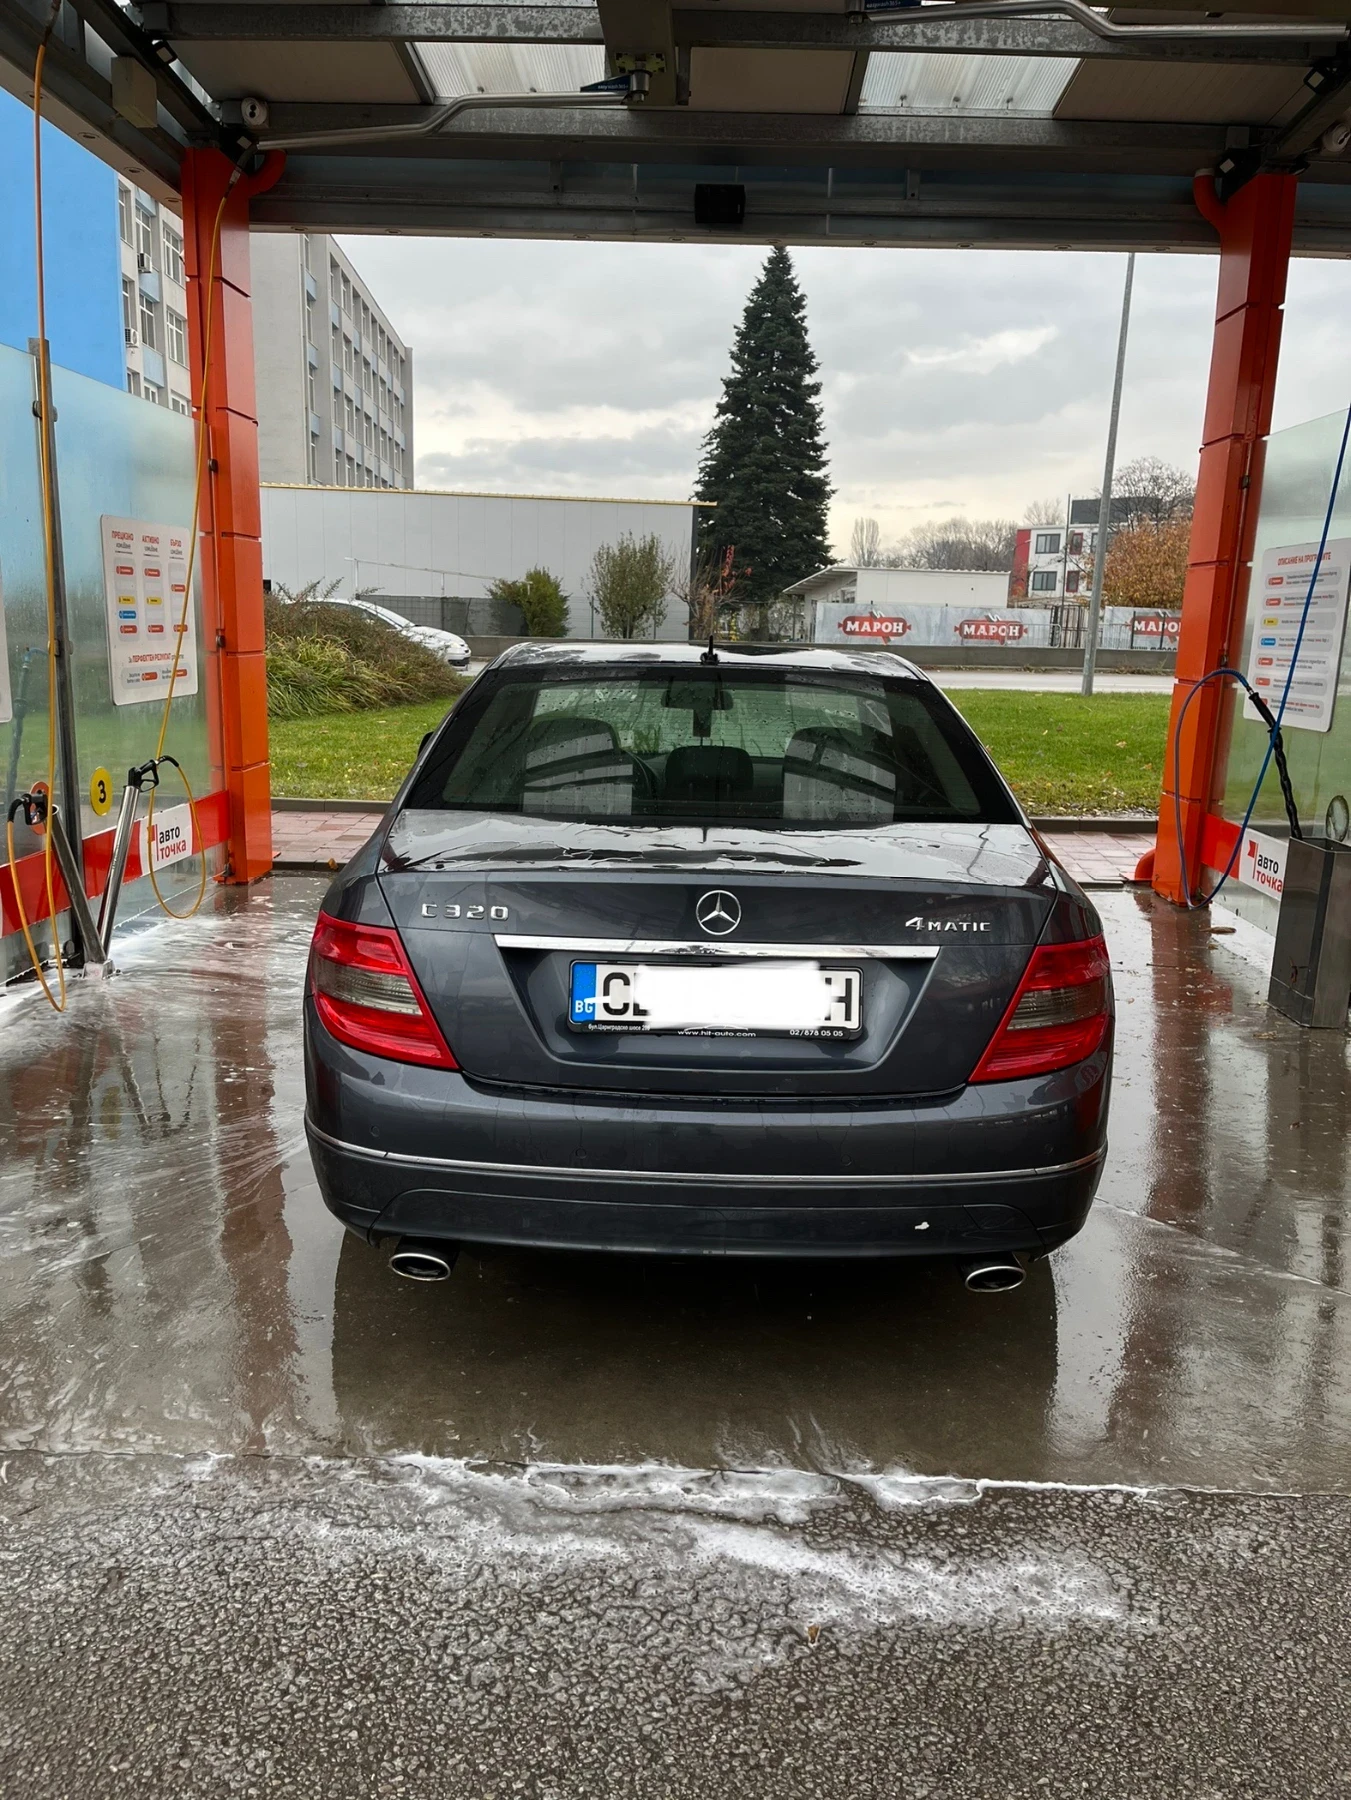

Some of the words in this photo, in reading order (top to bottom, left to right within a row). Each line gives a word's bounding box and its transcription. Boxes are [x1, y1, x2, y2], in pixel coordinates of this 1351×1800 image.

[845, 620, 904, 633] МАРОН
[963, 624, 1020, 636] МАРОН
[97, 780, 107, 804] 3
[159, 826, 180, 844] авто
[160, 839, 187, 860] точка
[1257, 854, 1279, 874] авто
[1256, 870, 1283, 892] точка
[905, 917, 991, 932] 4MATIC
[575, 1000, 594, 1013] BG
